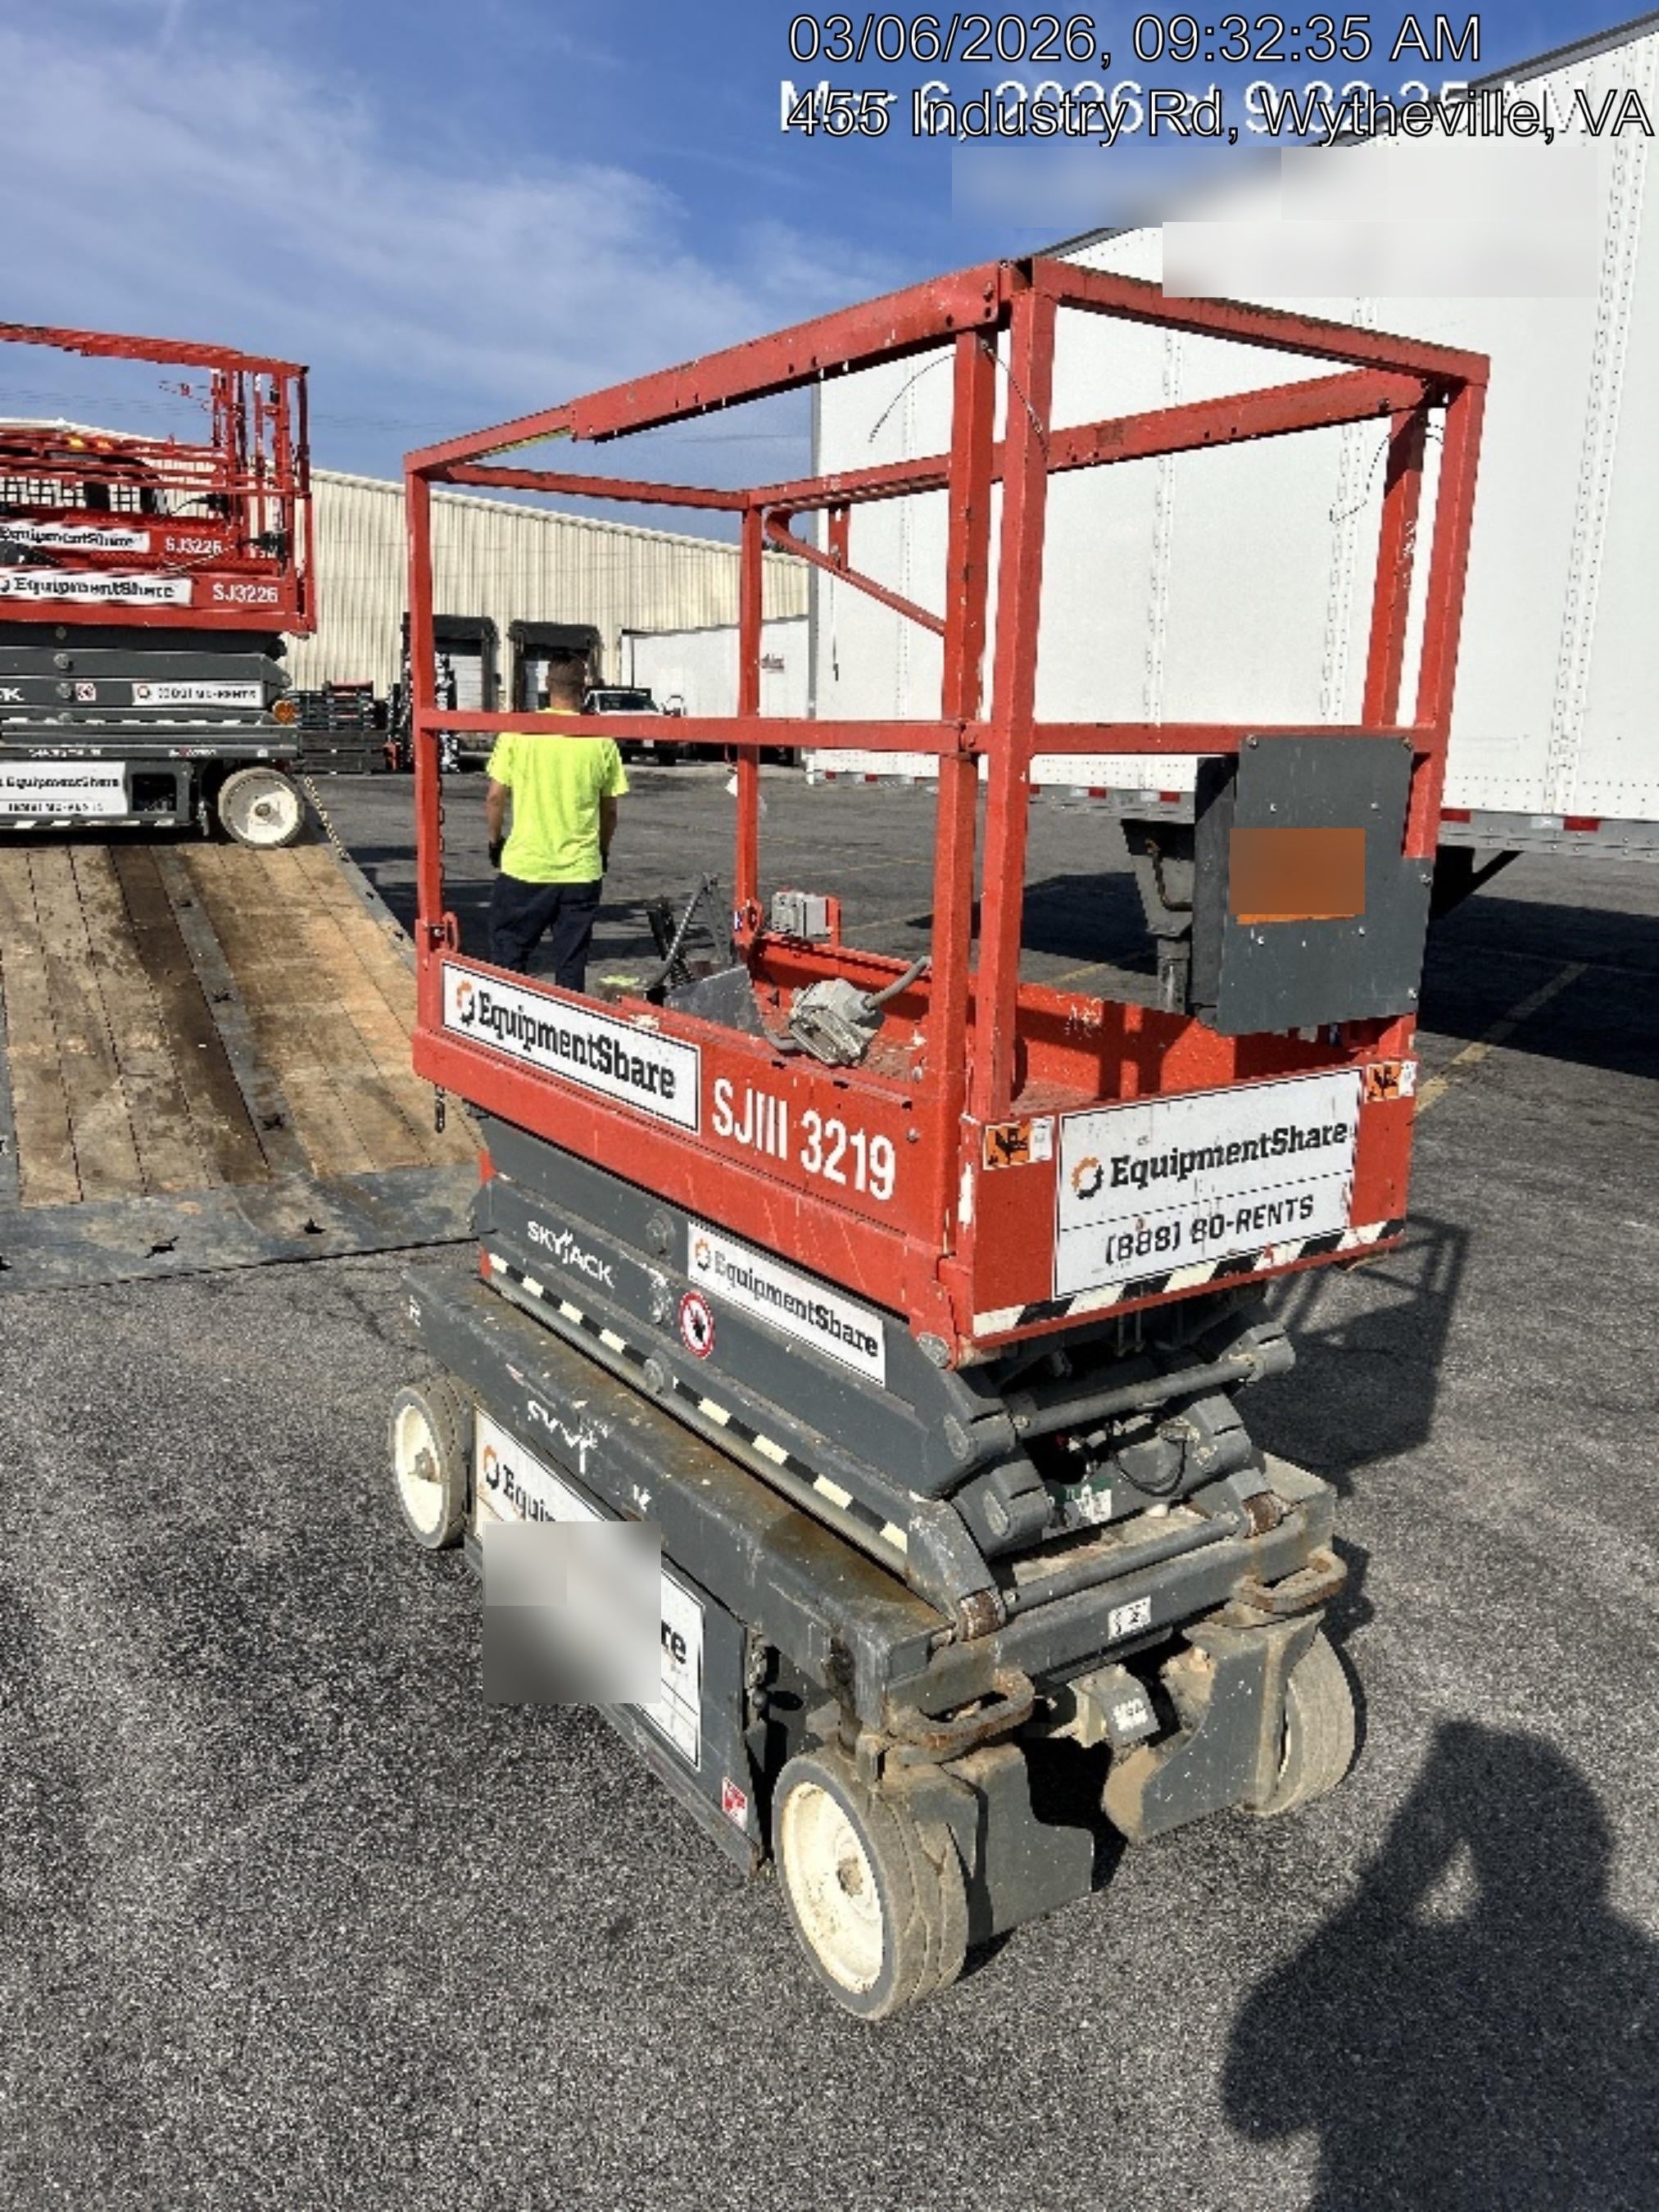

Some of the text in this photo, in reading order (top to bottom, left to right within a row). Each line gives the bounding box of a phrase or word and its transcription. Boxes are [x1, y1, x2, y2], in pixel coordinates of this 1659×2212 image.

[213, 582, 279, 604] SJ3226
[478, 990, 676, 1099] EquipmentShare
[712, 1078, 896, 1201] SJIII 3219
[1110, 1121, 1349, 1190] EquipmentShare
[1190, 1194, 1314, 1244] 80-RENTS
[527, 1220, 614, 1288] SKYJACK
[714, 1249, 879, 1358] EquipmentShare
